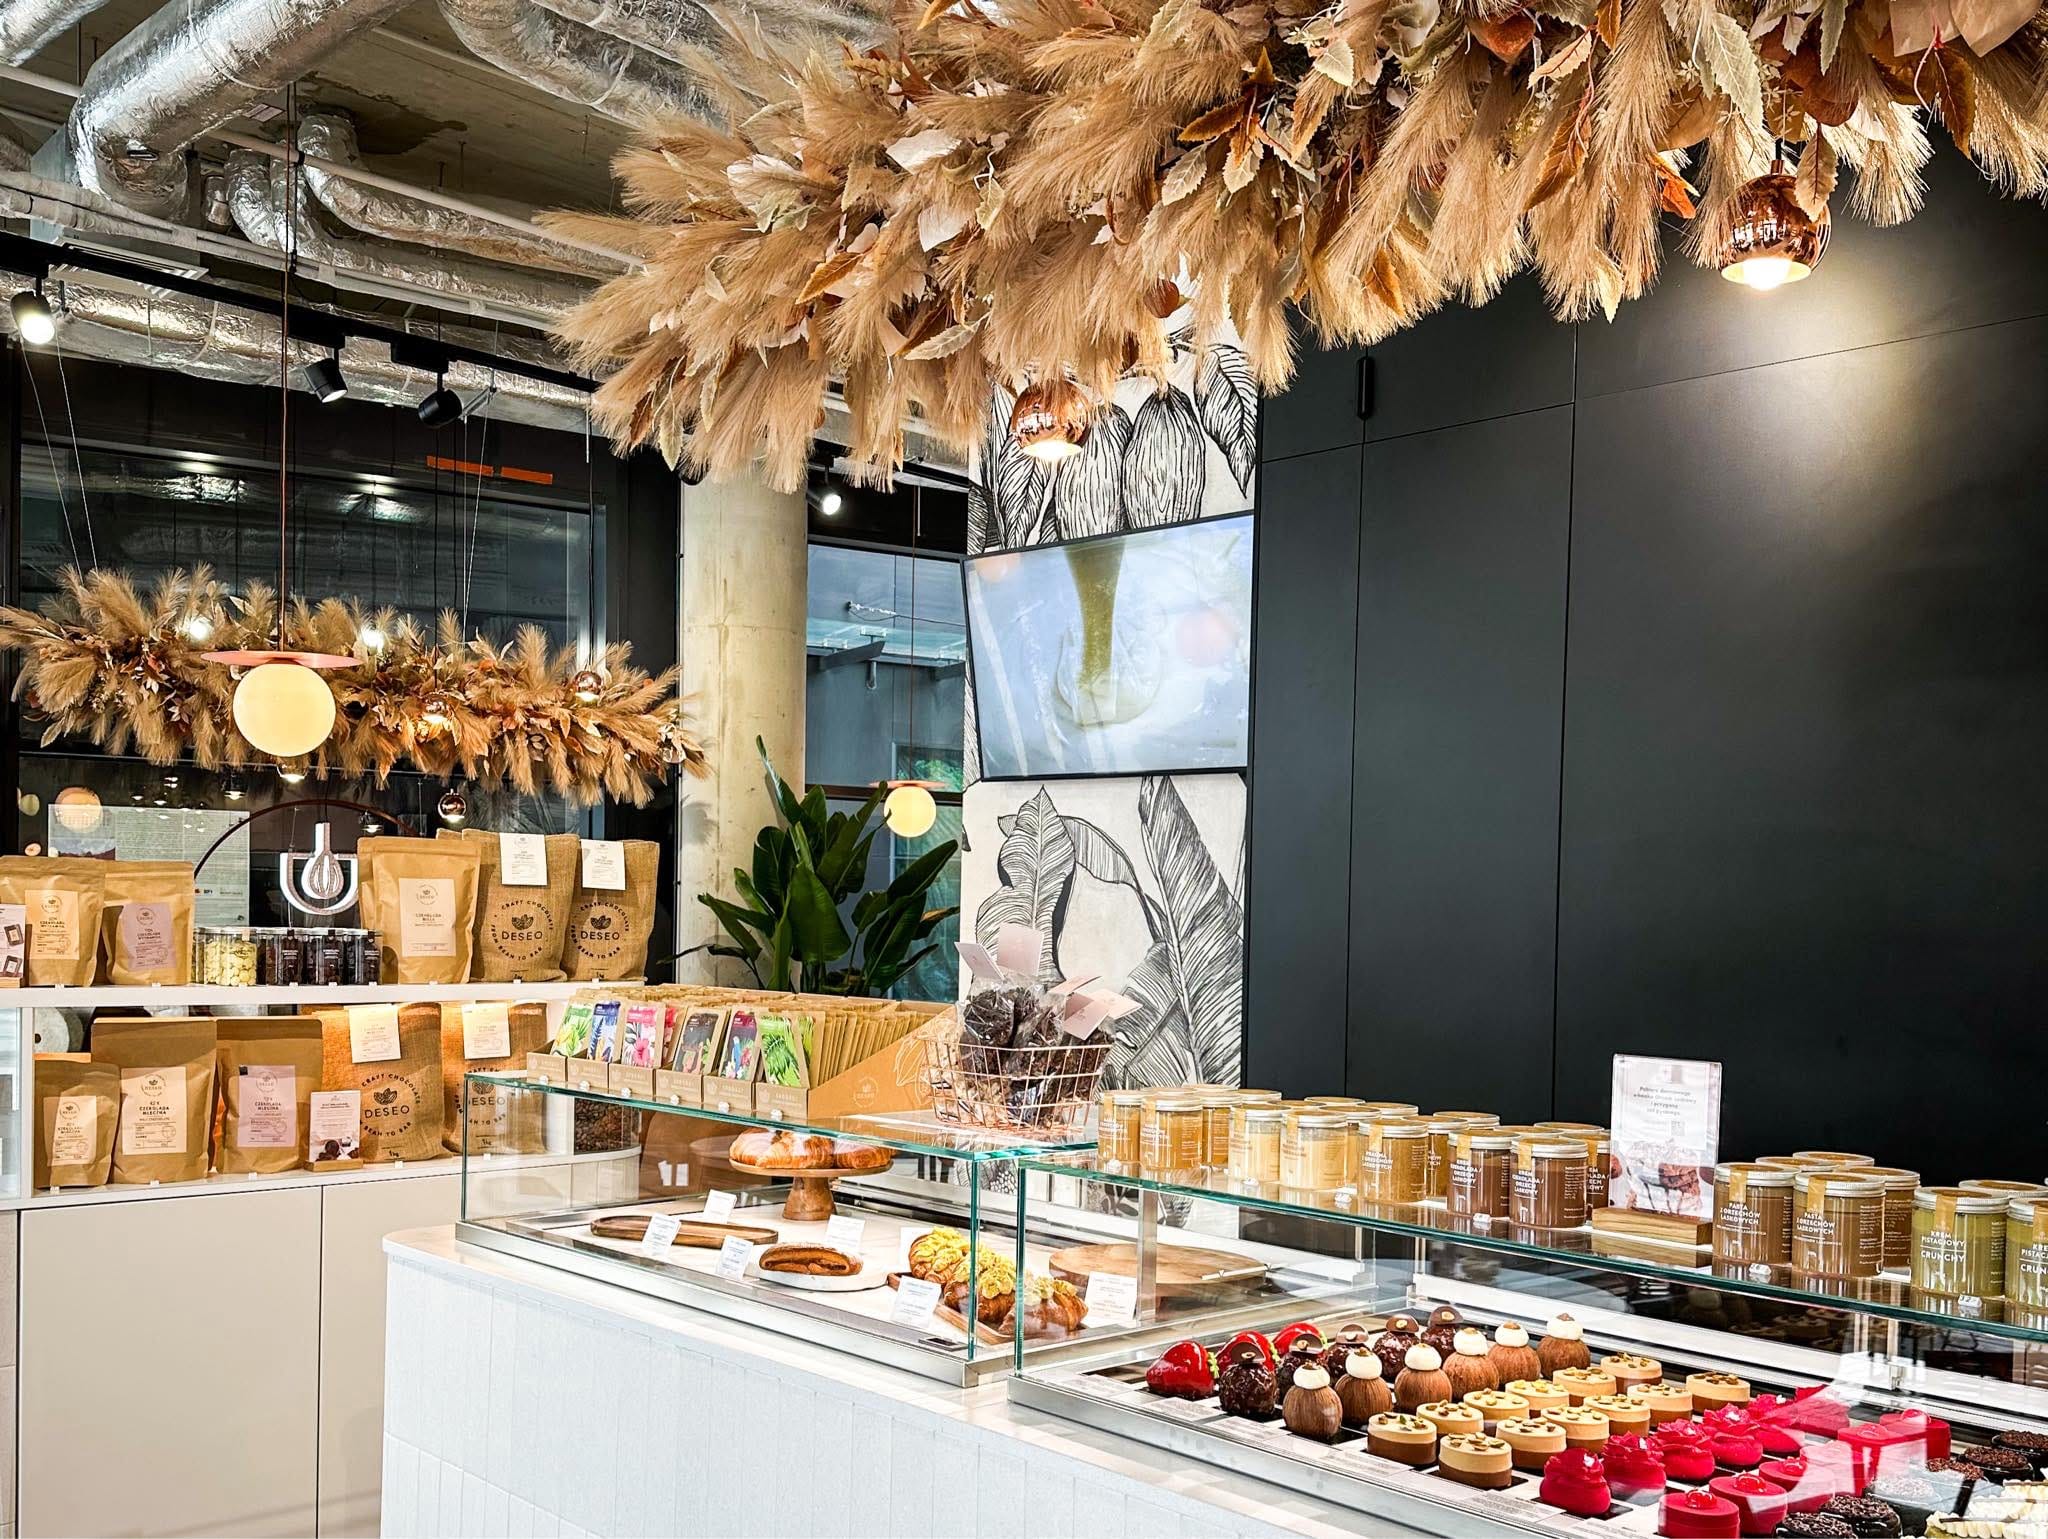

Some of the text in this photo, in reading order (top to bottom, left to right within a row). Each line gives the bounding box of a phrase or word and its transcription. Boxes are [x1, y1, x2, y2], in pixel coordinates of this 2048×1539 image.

[501, 900, 554, 930] CRAFT CHOCOLATE
[580, 902, 629, 931] CRAFT CHOCOLATE
[501, 930, 543, 941] DESEO
[580, 930, 620, 940] DESEO
[361, 1074, 421, 1104] CRAFT CHOCOLATE
[469, 1097, 505, 1106] ESEO
[364, 1105, 410, 1119] DESEO
[364, 1125, 383, 1137] BEAN
[1514, 1186, 1539, 1195] LASKOWY
[1729, 1202, 1748, 1210] PASTA
[1723, 1208, 1761, 1219] ORZECHÓW
[1804, 1212, 1823, 1220] PASTA
[1720, 1214, 1759, 1225] LASKOWYCH
[1800, 1217, 1835, 1229] ORZECHÓW
[1796, 1224, 1834, 1235] LASKOWYCH
[1930, 1230, 1951, 1239] KREM
[1921, 1236, 1966, 1247] PISTACJOWY
[1921, 1250, 1965, 1263] CRUNCHY
[2020, 1263, 2048, 1275] CRUN
